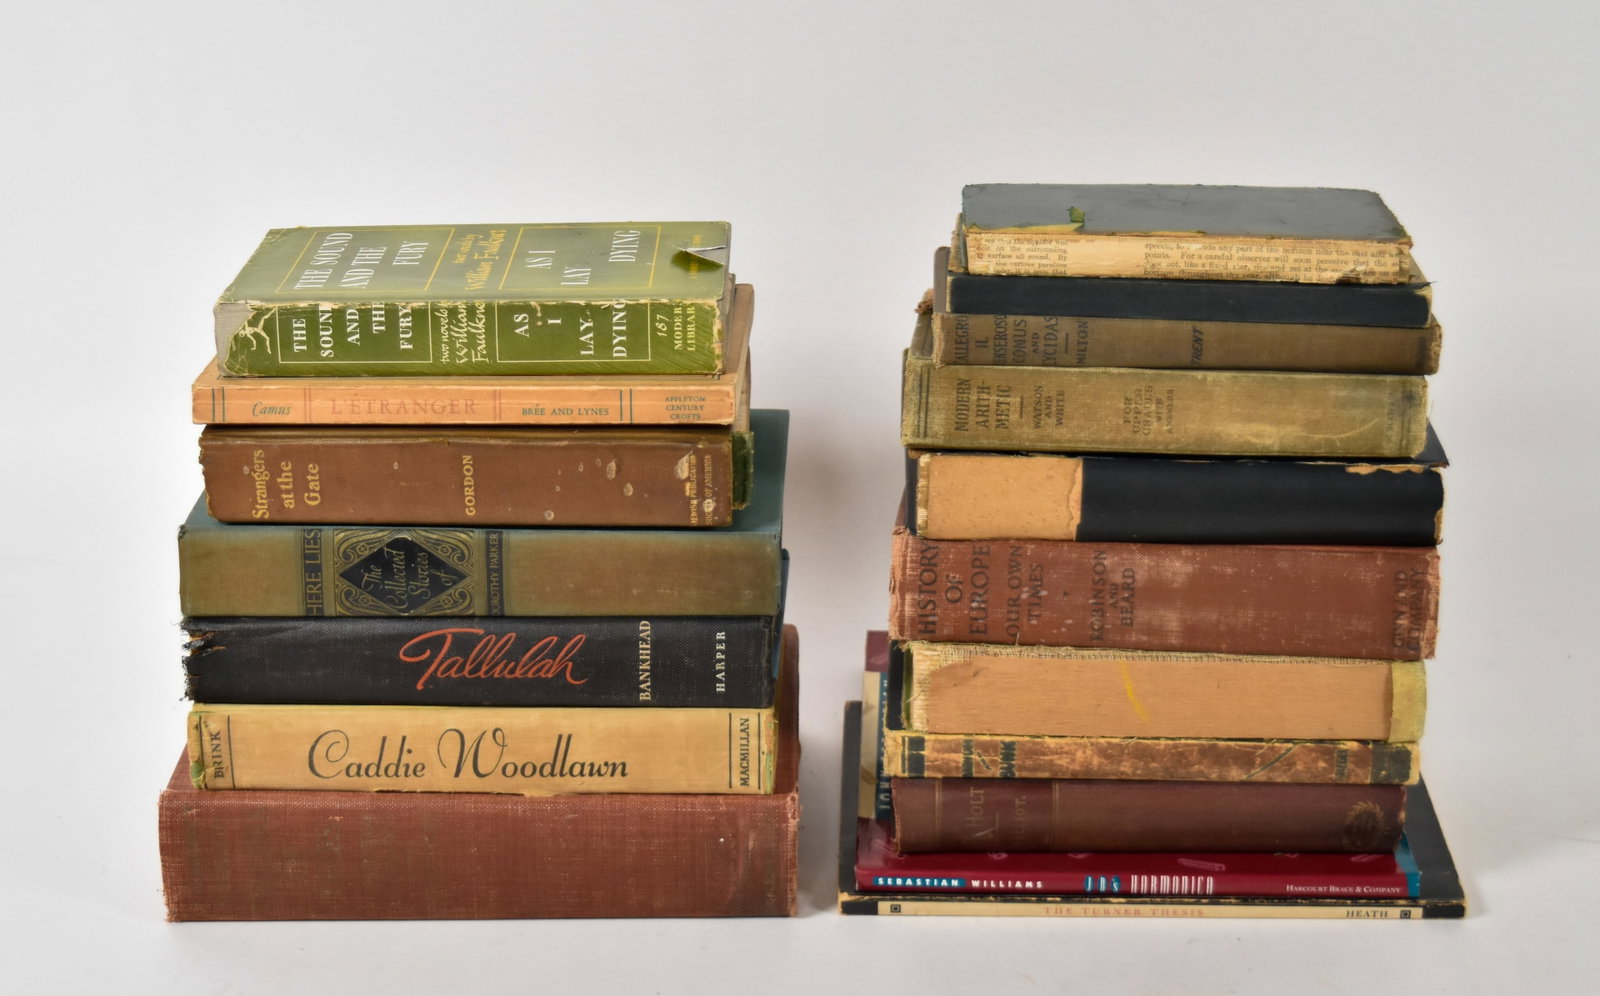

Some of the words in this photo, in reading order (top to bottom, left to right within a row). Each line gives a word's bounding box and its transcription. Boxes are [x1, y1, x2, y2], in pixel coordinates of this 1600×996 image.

[310, 232, 353, 265] SOUND
[351, 246, 387, 265] THE
[392, 240, 430, 266] FURY
[524, 257, 553, 269] AS
[609, 230, 641, 262] DYING
[294, 269, 333, 289] THE
[338, 268, 375, 289] AND
[561, 266, 592, 286] LAY
[293, 318, 307, 352] THE
[346, 309, 361, 346] AND
[399, 305, 413, 350] FURY
[434, 309, 449, 342] novels
[468, 300, 489, 363] Faulkne
[514, 313, 529, 338] AS
[548, 317, 561, 325] I
[579, 318, 594, 355] LAY
[656, 314, 669, 337] 187
[686, 305, 696, 351] LIBRAR
[954, 314, 971, 364] ALLEGRO
[993, 314, 1008, 364] ENSEROSO
[1013, 319, 1027, 363] COMUS
[440, 344, 450, 364] two
[975, 337, 988, 349] IL
[1076, 320, 1088, 365] MILTON
[1191, 325, 1204, 365] TRENT
[252, 401, 292, 417] Camus
[551, 407, 573, 416] AND
[577, 407, 609, 416] LYNES
[955, 377, 971, 432] MODERN
[976, 380, 991, 430] ARITH-
[994, 384, 1011, 430] METIC
[1033, 385, 1043, 430] WATSON
[1055, 390, 1065, 426] WHITE
[1123, 397, 1132, 425] FOR
[1132, 389, 1142, 434] UPPER
[1142, 385, 1153, 436] GRADES
[252, 449, 270, 519] Strangers
[276, 460, 294, 491] the
[304, 463, 321, 506] Gate
[462, 455, 476, 516] GORDON
[280, 491, 295, 510] at
[304, 529, 322, 567] LIES
[489, 532, 499, 569] PARKER
[1008, 545, 1023, 590] OWN
[305, 569, 324, 616] HERE
[361, 564, 384, 592] The
[384, 547, 408, 609] Collected
[408, 552, 430, 600] Stories
[430, 568, 459, 586] of
[918, 541, 938, 635] HISTORY
[945, 574, 963, 604] OF
[970, 545, 990, 636] EUROPE
[1028, 564, 1044, 621] TIMES
[1088, 550, 1107, 641] ROBINSON
[1108, 583, 1118, 608] AND
[1006, 596, 1021, 637] OUR
[1120, 567, 1135, 628] BEARD
[399, 627, 588, 691] Tallulah
[639, 620, 651, 702] BANKHEAD
[715, 631, 726, 692] HARPER
[210, 730, 224, 779] BRINK
[308, 729, 426, 779] Caddie
[437, 727, 628, 778] Woodlawn
[739, 717, 750, 787] MACMILLAN
[966, 786, 984, 827] HOLT
[878, 877, 959, 887] SEBASTIAN
[971, 879, 1043, 889] WILLIAMS
[1355, 885, 1361, 893] &
[1044, 907, 1073, 915] THE
[1082, 907, 1142, 916] TURNER
[1151, 908, 1204, 916] THESIS
[1346, 910, 1388, 918] HEATH
